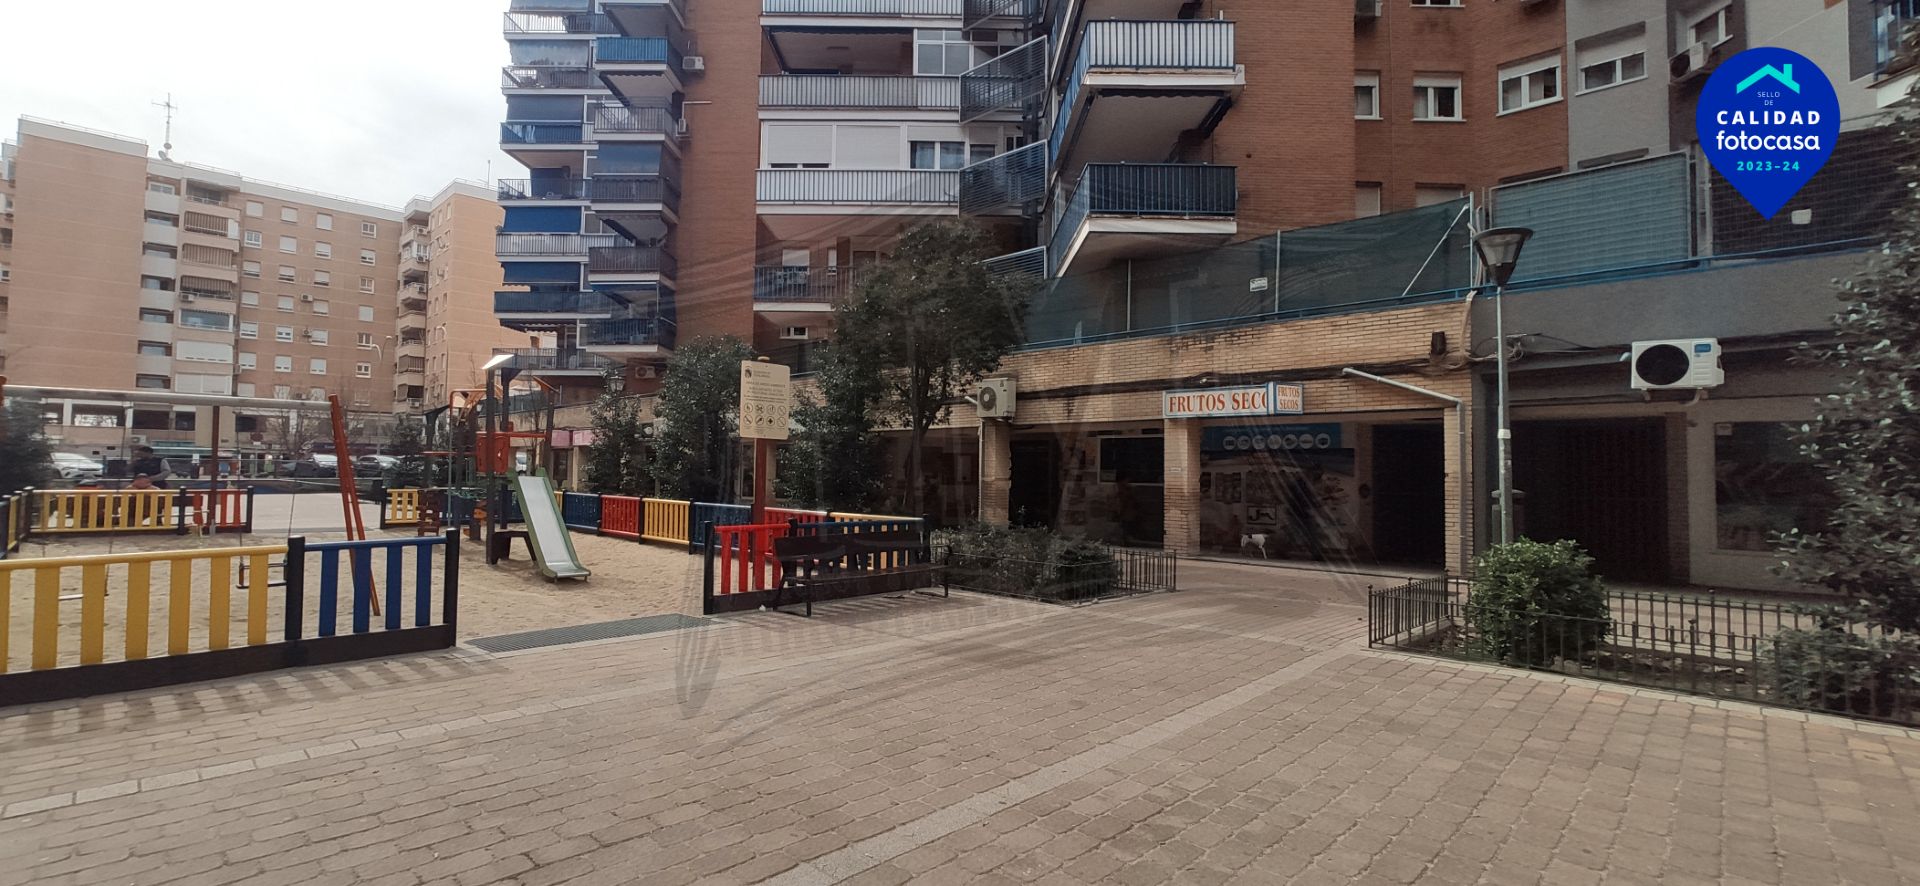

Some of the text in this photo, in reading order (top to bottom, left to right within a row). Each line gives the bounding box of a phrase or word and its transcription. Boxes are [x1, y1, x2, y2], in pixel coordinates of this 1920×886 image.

[1278, 386, 1300, 397] FRUTOS
[1169, 393, 1225, 413] FRUTOS
[1280, 399, 1299, 410] SECOS
